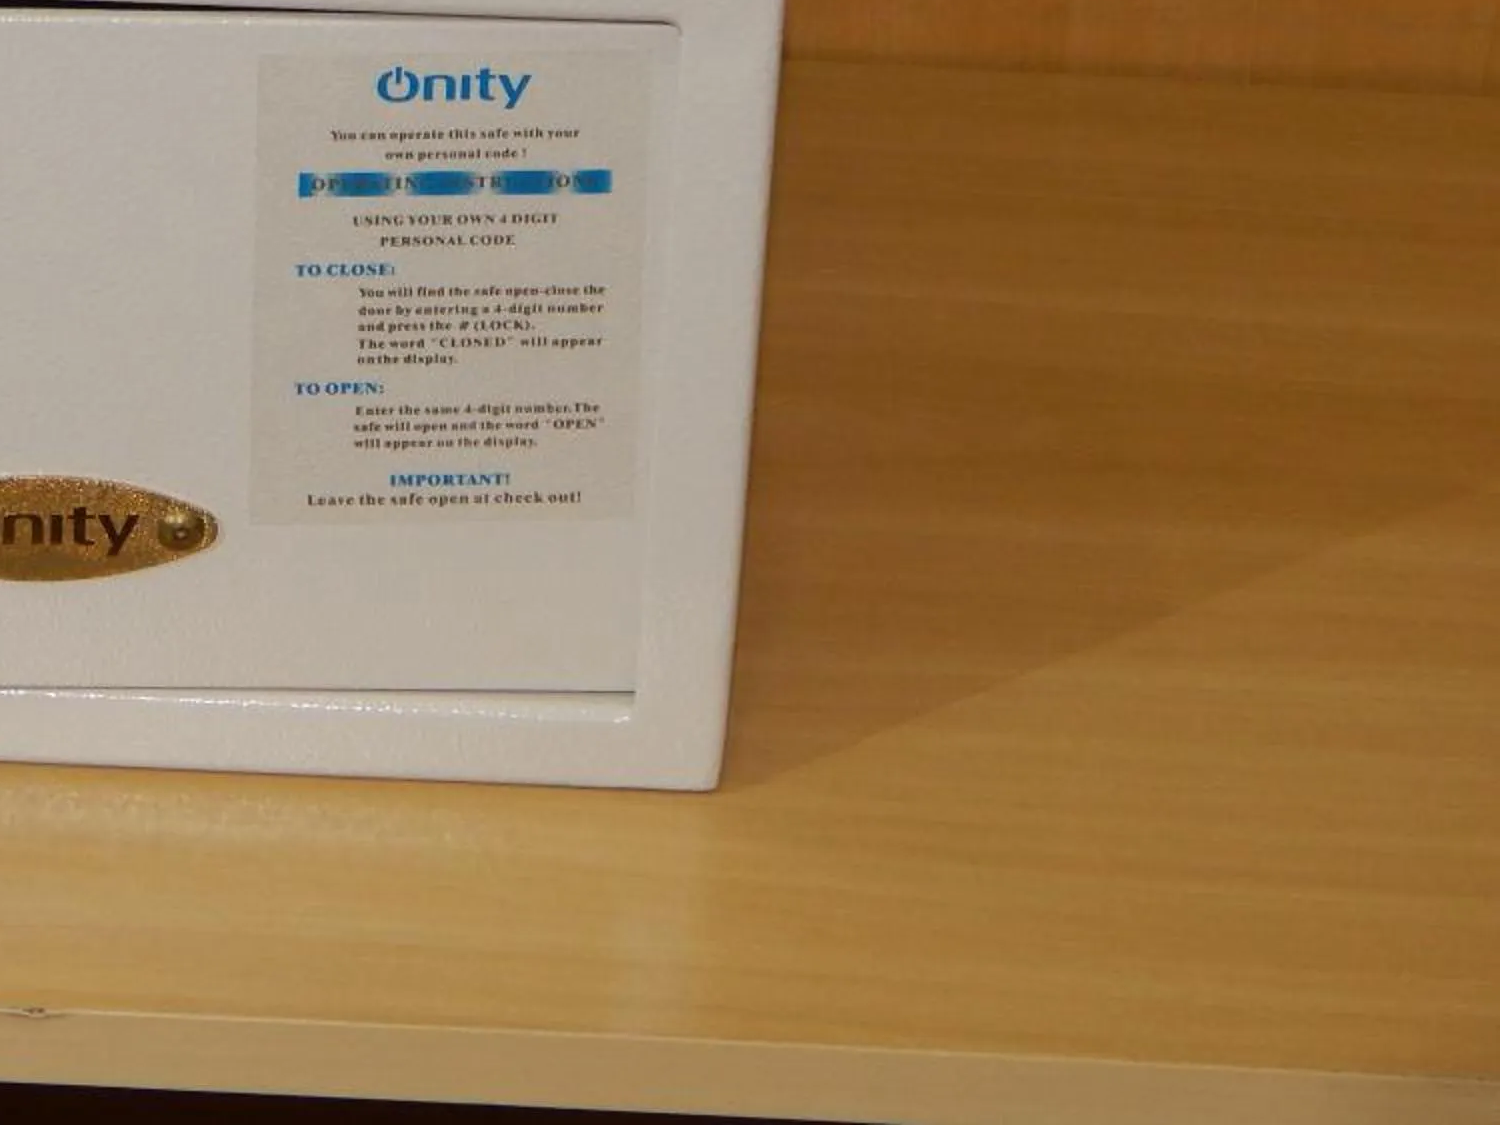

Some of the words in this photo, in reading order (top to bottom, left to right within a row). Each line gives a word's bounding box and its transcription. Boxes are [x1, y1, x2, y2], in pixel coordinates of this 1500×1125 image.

[376, 65, 533, 109] Onity
[330, 131, 356, 142] You
[389, 131, 444, 142] operate
[448, 129, 476, 139] this
[480, 128, 509, 139] safe
[513, 127, 544, 138] with
[548, 128, 579, 139] your
[385, 151, 414, 160] own
[417, 149, 481, 161] personal
[485, 148, 518, 158] code
[353, 215, 404, 227] USING
[407, 215, 453, 226] YOUR
[457, 215, 495, 226] OWN
[510, 213, 558, 224] DIGIT
[379, 235, 467, 247] PERSONAL
[469, 235, 516, 246] CODE
[295, 263, 321, 277] TO
[326, 263, 396, 276] CLOSE:
[359, 288, 384, 297] You
[388, 287, 413, 297] will
[417, 287, 444, 297] find
[449, 287, 469, 297] the
[474, 286, 501, 296] safe
[506, 285, 579, 297] open-close
[583, 284, 604, 295] the
[395, 305, 411, 316] by
[415, 305, 477, 316] entering
[494, 303, 542, 315] 4-digit
[547, 303, 604, 313] number
[358, 320, 384, 331] and
[388, 322, 425, 334] press
[430, 320, 452, 331] the
[359, 339, 385, 349] The
[390, 339, 425, 348] word
[521, 337, 547, 346] will
[551, 338, 602, 349] appear
[294, 382, 320, 395] TO
[325, 382, 385, 395] OPEN:
[355, 405, 394, 416] Enter
[399, 404, 421, 415] the
[425, 405, 460, 415] same
[464, 403, 512, 416] 4-digit
[354, 422, 382, 433] safe
[385, 422, 411, 432] will
[413, 422, 447, 434] open
[451, 421, 477, 431] and
[480, 420, 502, 431] the
[505, 420, 539, 429] word
[354, 438, 381, 449] will
[385, 439, 432, 450] appear
[436, 439, 454, 448] on
[458, 437, 481, 447] the
[389, 473, 510, 487] IMPORTANT!
[307, 494, 354, 506] Leave
[359, 494, 385, 505] the
[390, 493, 424, 505] safe
[428, 494, 469, 507] open
[473, 492, 489, 504] at
[495, 491, 544, 504] check
[548, 490, 582, 504] out!
